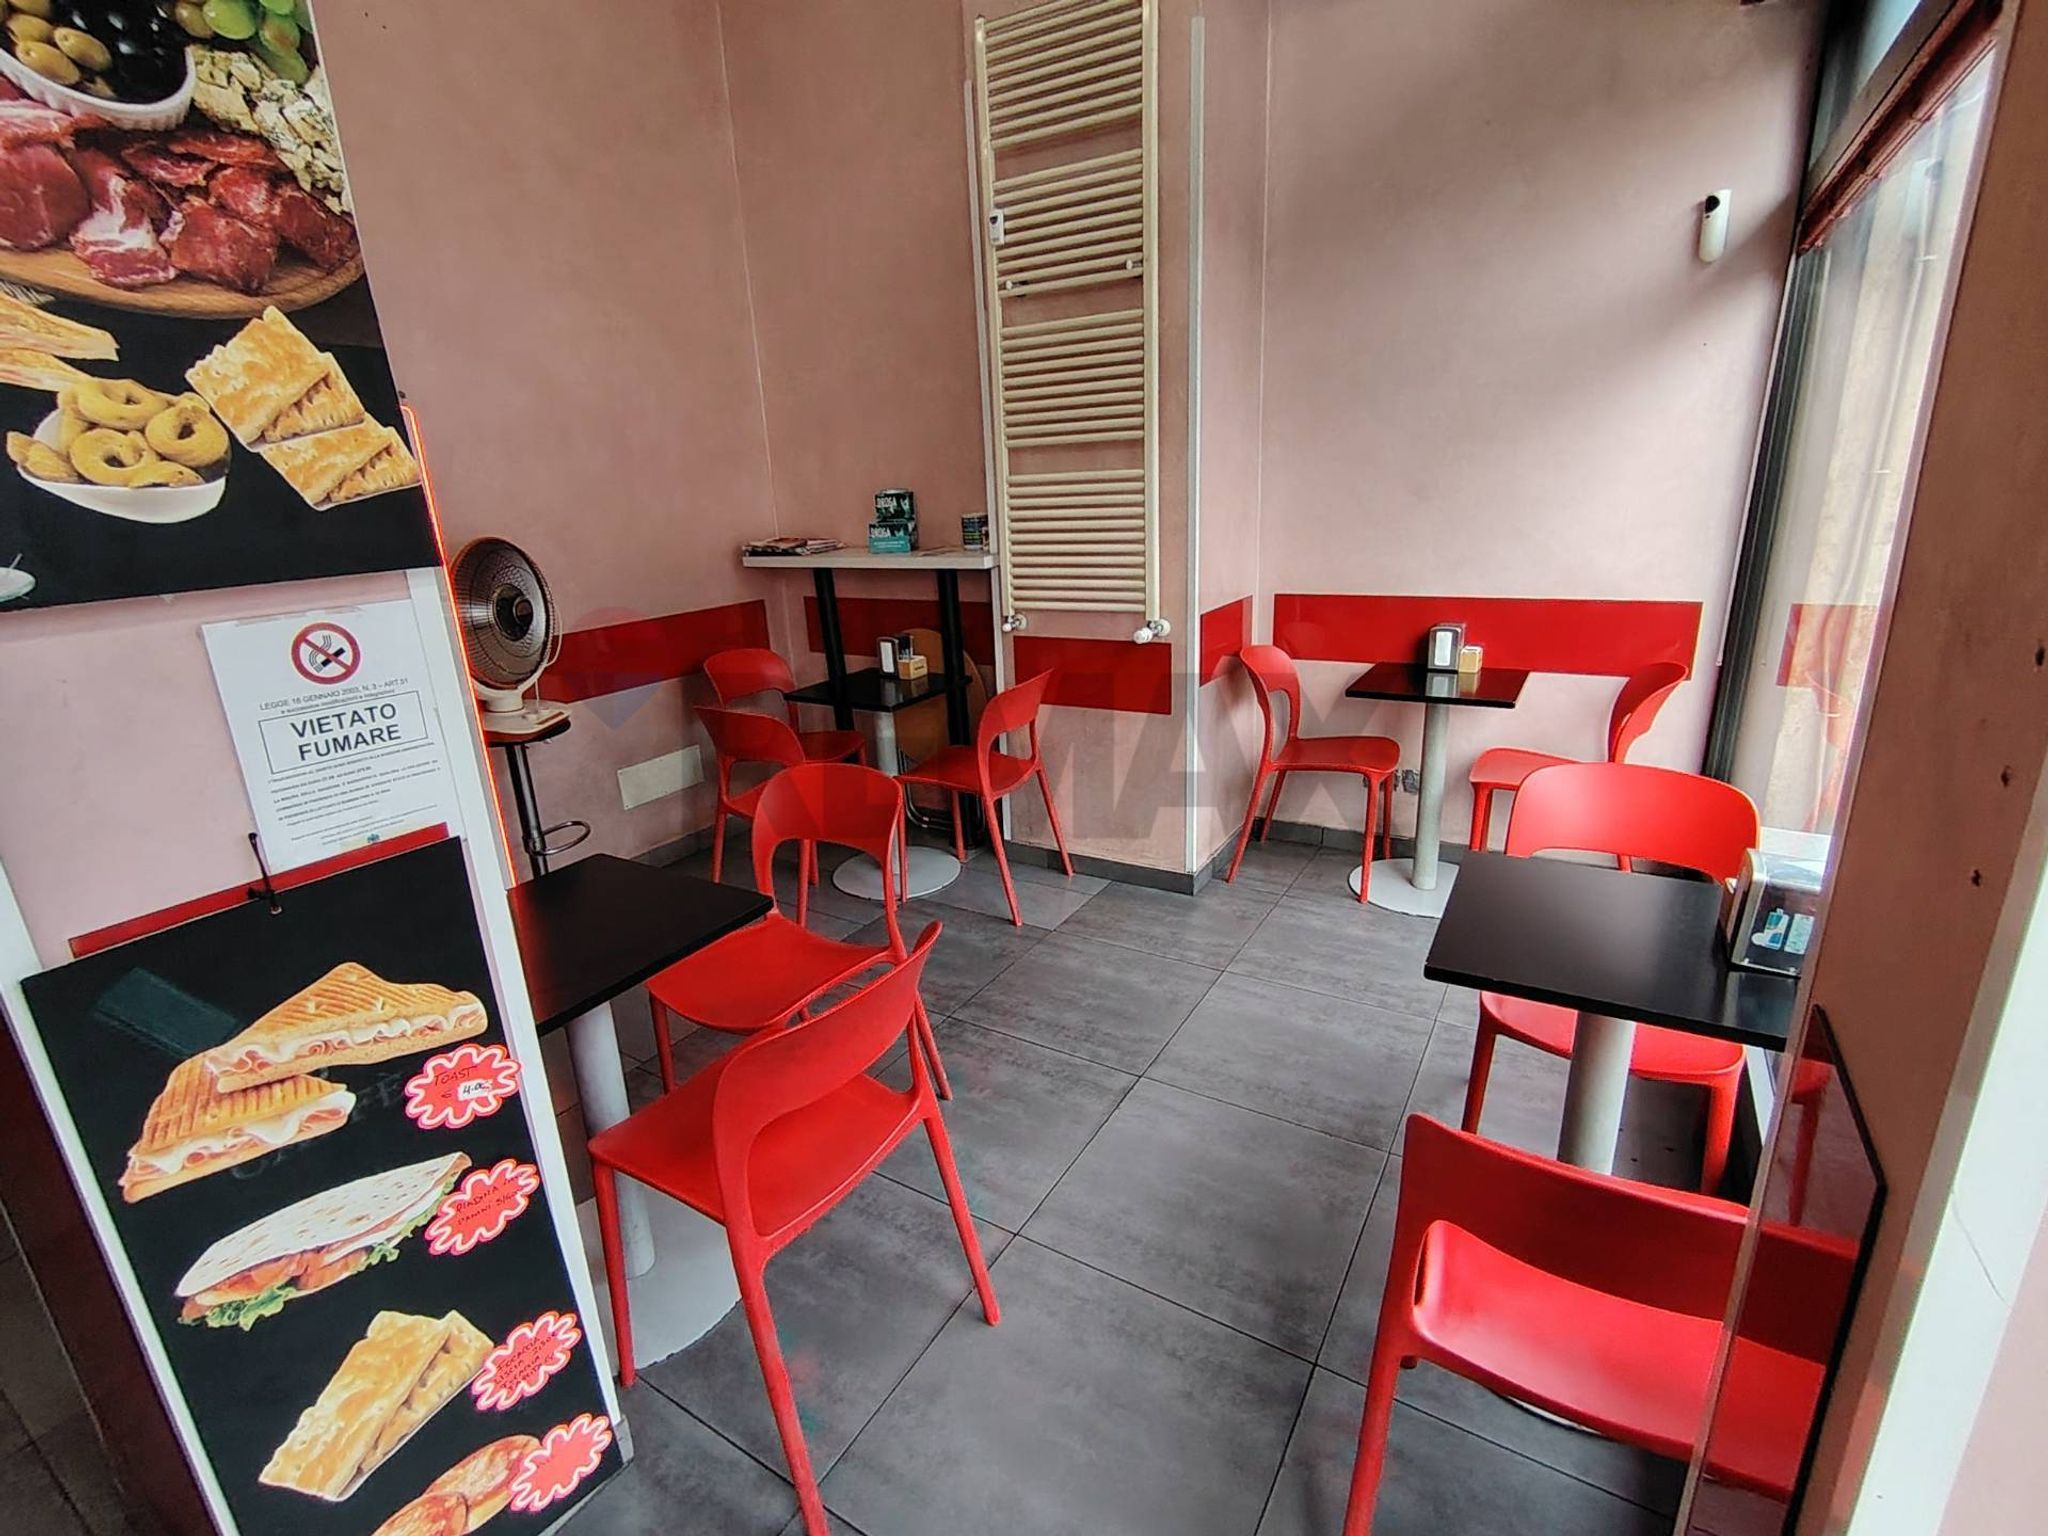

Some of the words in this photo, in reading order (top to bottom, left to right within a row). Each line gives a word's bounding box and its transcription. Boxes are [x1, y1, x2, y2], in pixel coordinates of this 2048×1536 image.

[259, 699, 289, 711] LEGGE
[303, 690, 341, 703] GENNAIO
[290, 703, 397, 738] VIETATO
[298, 724, 402, 761] FUMARE
[434, 1065, 478, 1087] TOAST
